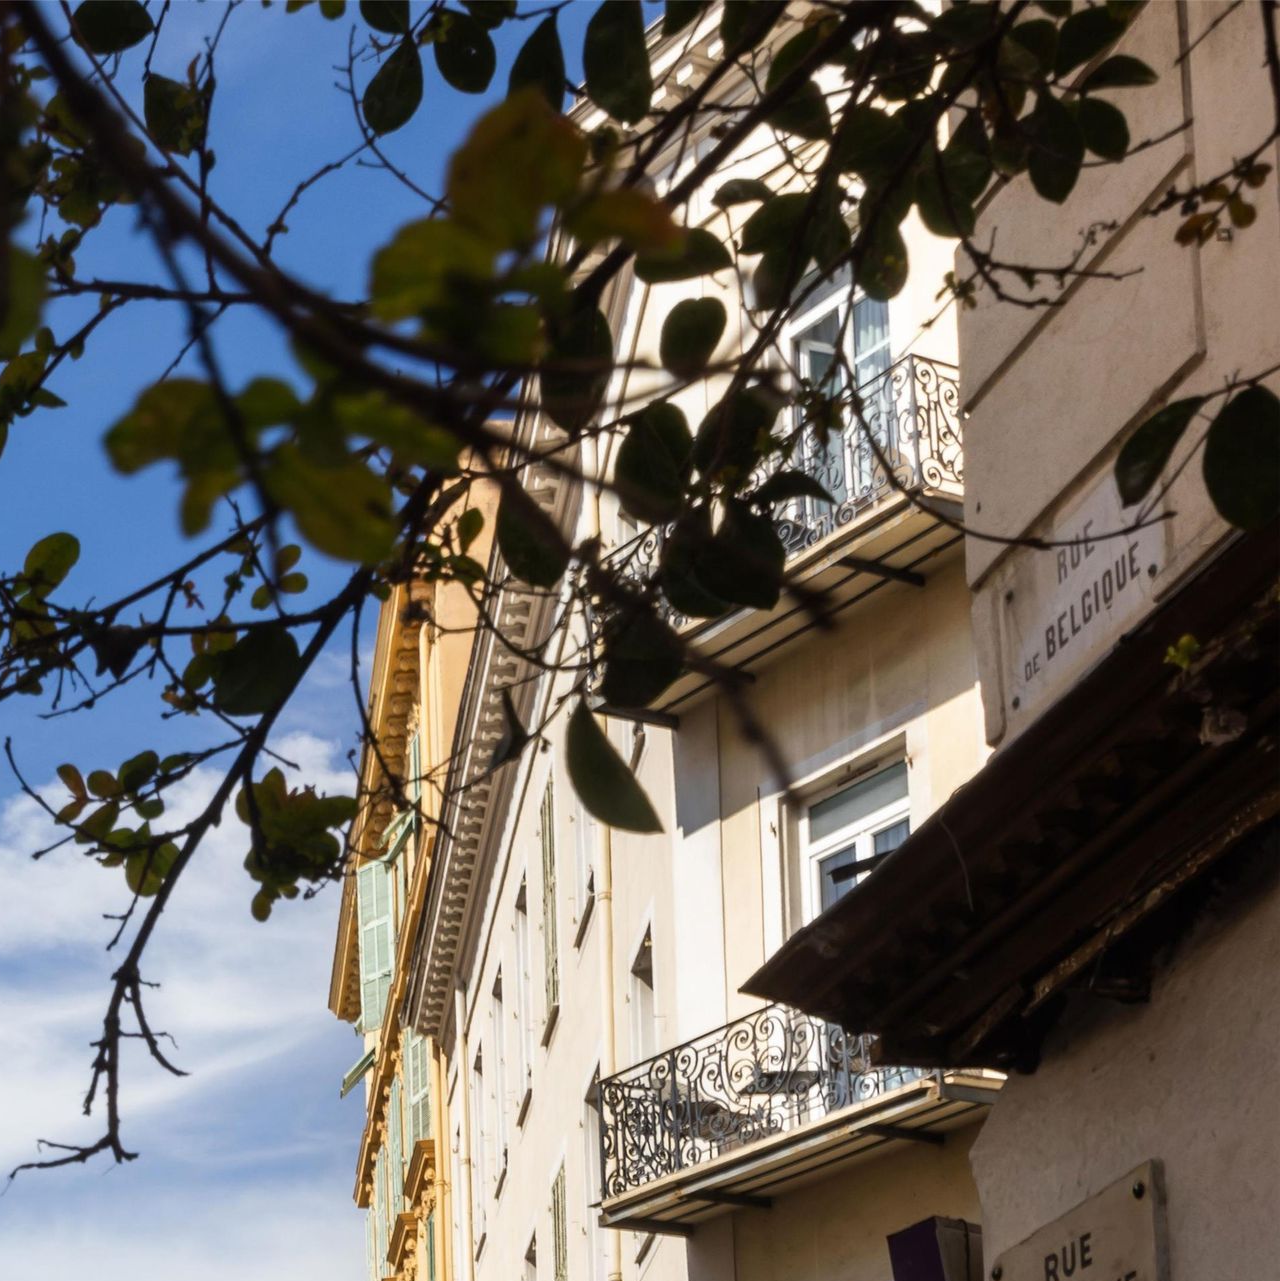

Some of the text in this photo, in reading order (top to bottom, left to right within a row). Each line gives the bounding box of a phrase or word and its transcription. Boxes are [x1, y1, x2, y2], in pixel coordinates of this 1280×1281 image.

[1057, 518, 1096, 585] RUE
[1025, 541, 1140, 682] DE BELGIQUE
